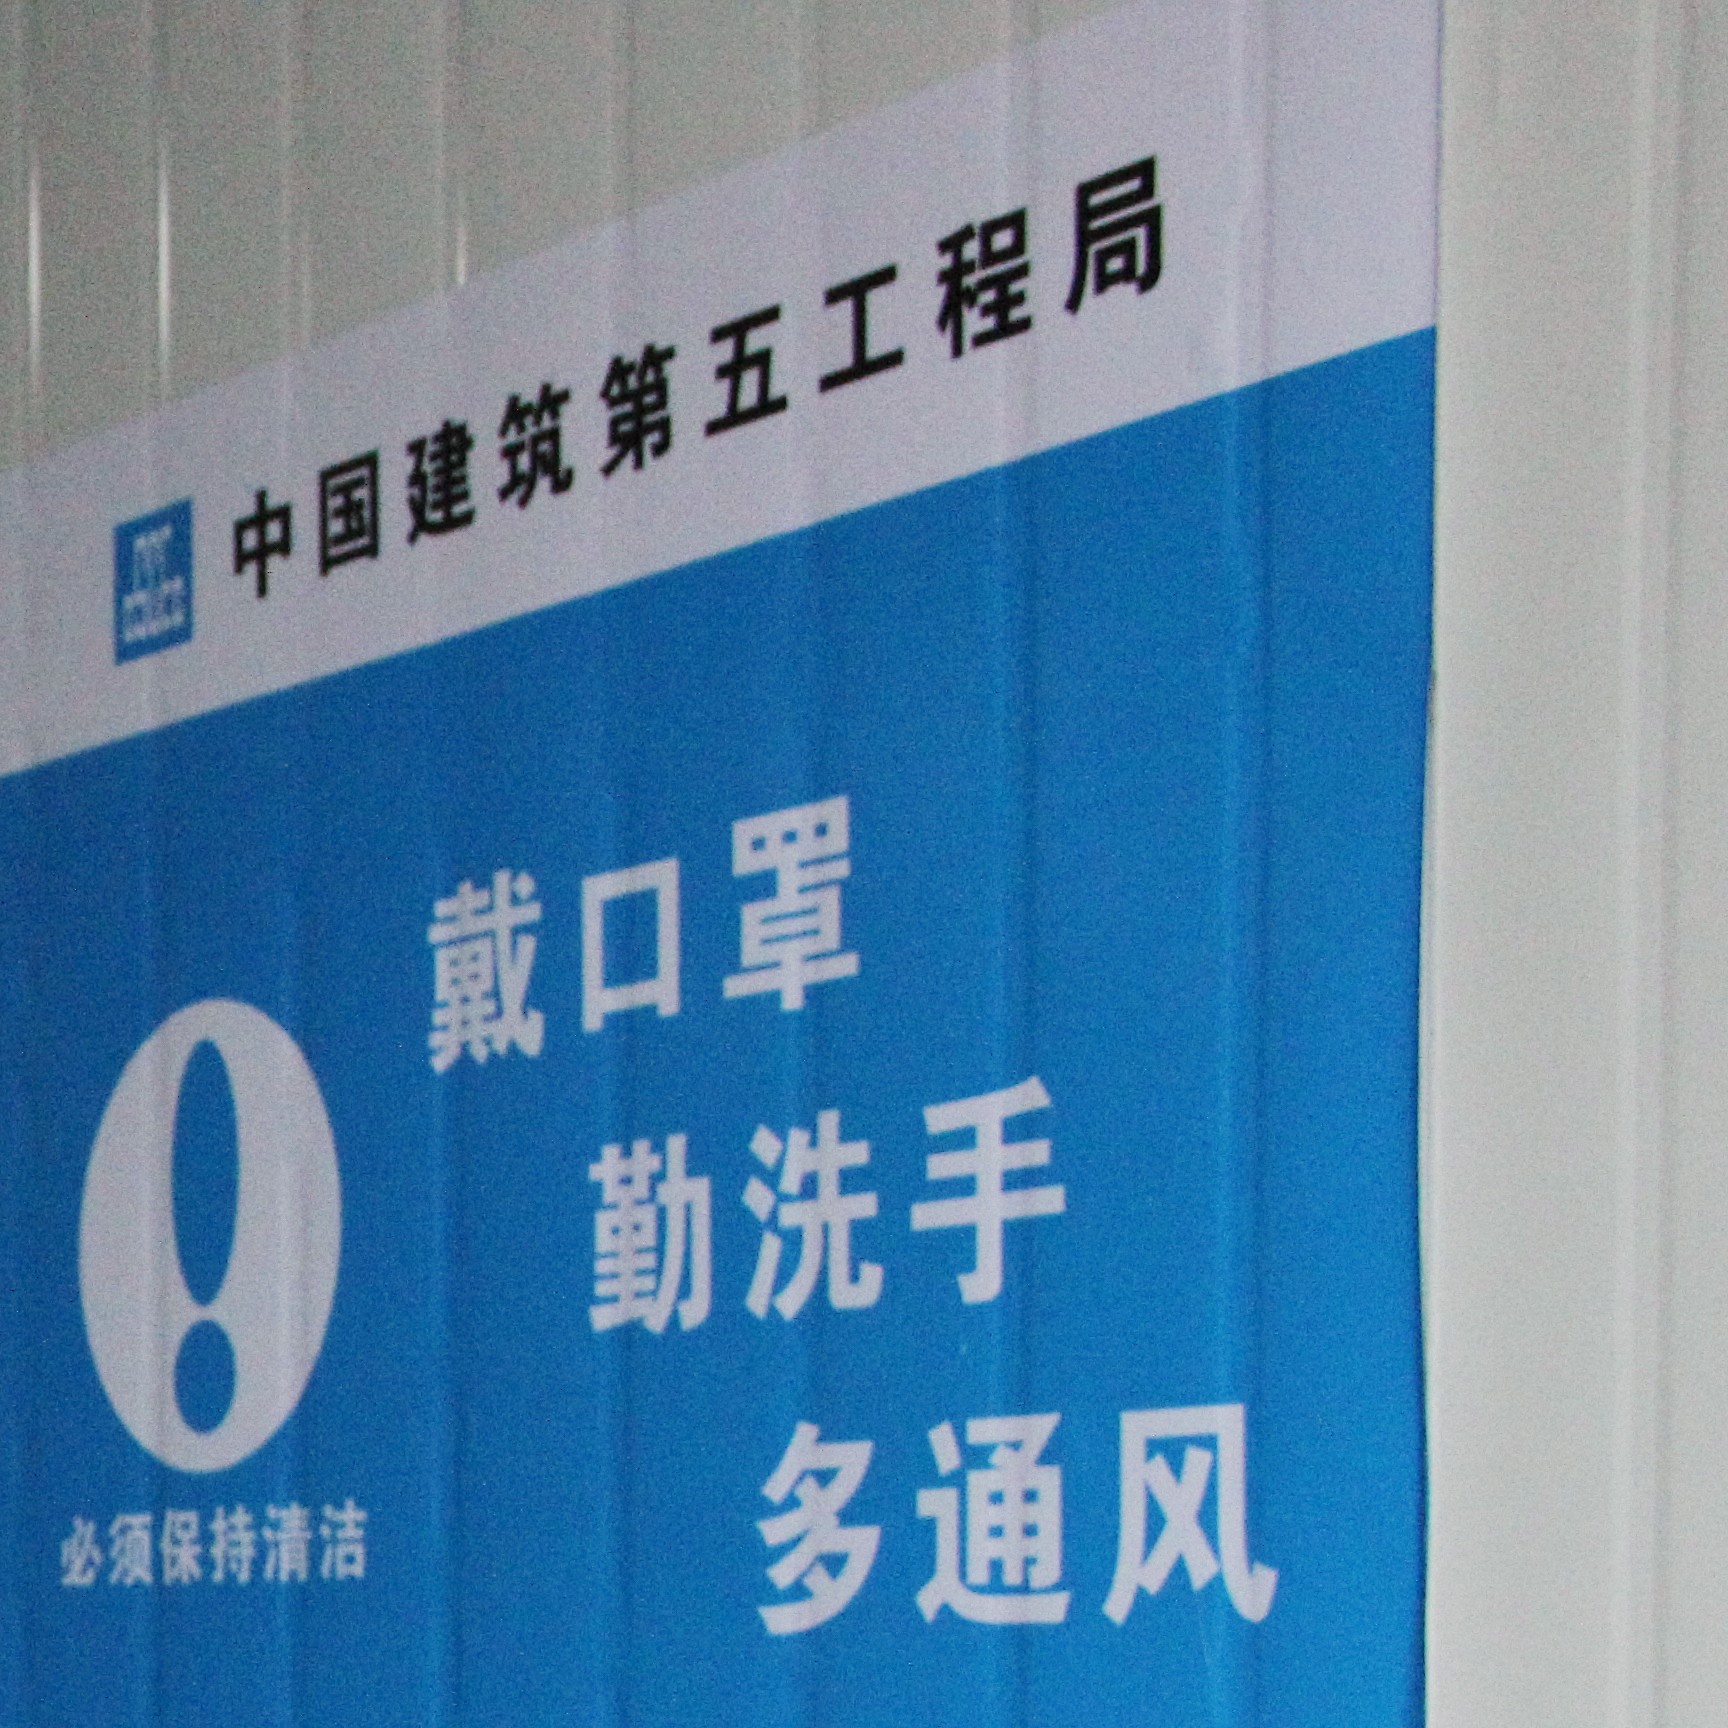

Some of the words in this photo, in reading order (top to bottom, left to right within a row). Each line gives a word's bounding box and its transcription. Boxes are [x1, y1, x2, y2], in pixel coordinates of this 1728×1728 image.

[233, 154, 1164, 599] 中国建筑第五工程局
[425, 795, 861, 1075] 戴口罩
[586, 1074, 1067, 1335] 勤洗手
[59, 1496, 369, 1587] 必须保持清洁
[755, 1401, 1280, 1636] 多通风
